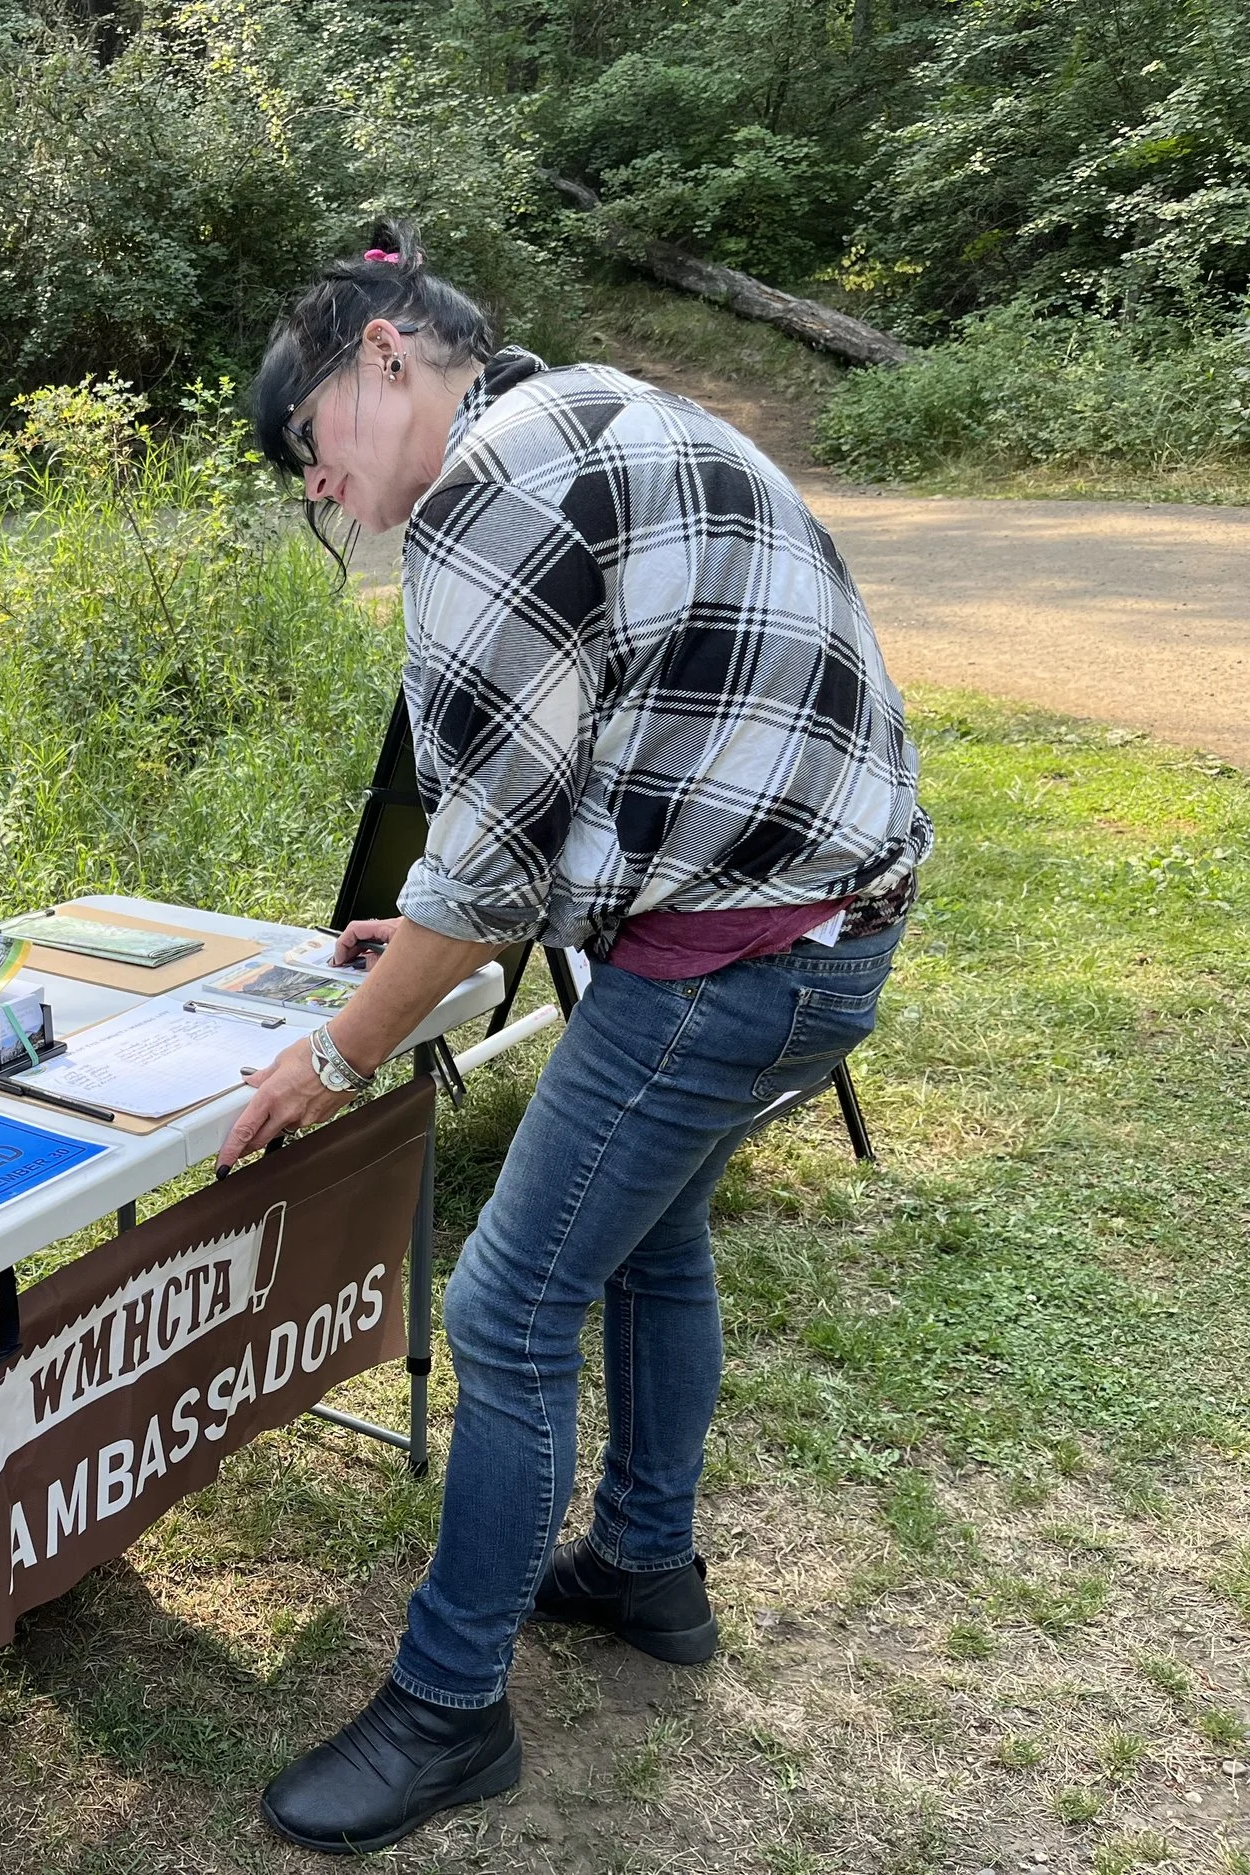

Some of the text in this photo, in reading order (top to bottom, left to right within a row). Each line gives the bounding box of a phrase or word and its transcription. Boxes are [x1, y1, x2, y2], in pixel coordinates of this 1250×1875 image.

[46, 1146, 71, 1160] 30
[30, 1258, 232, 1425] WMHCTA
[7, 1263, 387, 1596] AMBASSADORS
